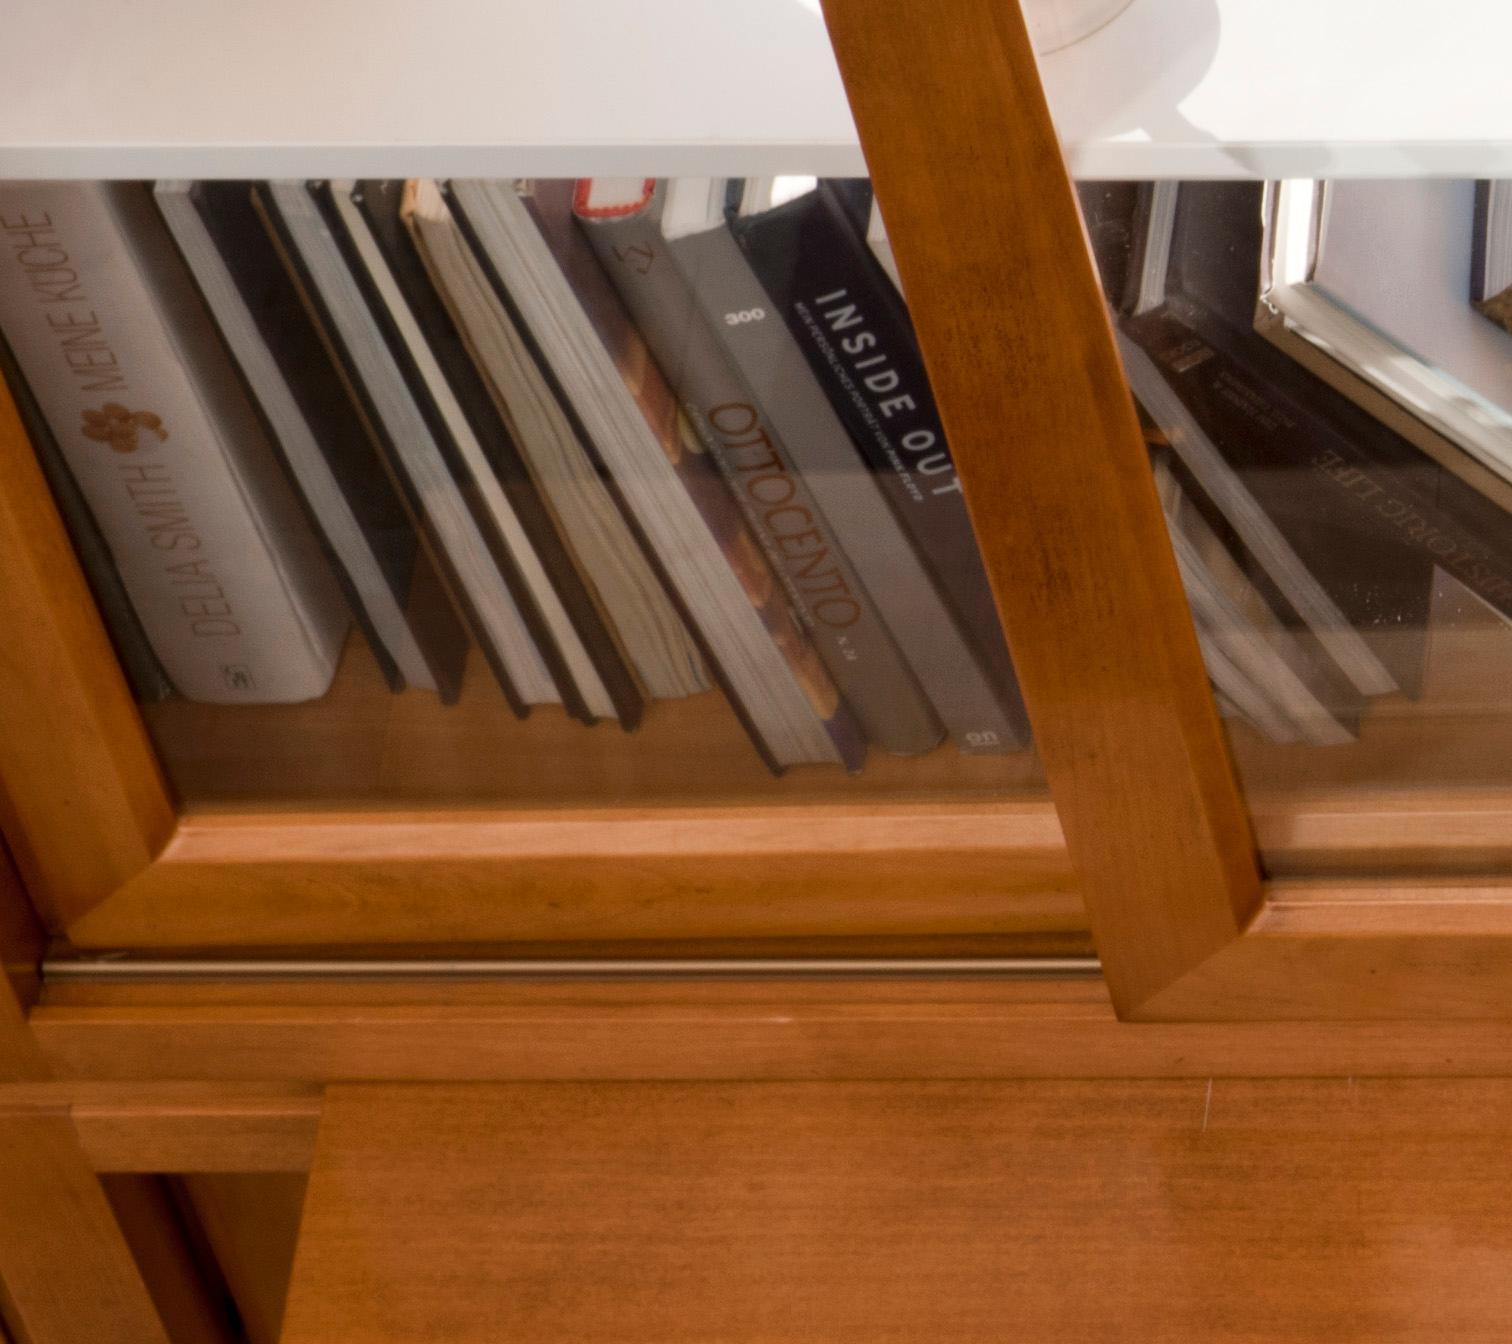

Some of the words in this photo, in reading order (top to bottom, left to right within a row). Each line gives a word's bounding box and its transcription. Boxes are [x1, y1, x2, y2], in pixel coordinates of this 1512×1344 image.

[45, 309, 130, 394] MEINE
[724, 306, 766, 327] 300
[815, 288, 918, 419] INSIDE
[901, 429, 966, 497] OUT
[120, 461, 203, 552] SMITH
[707, 401, 862, 630] OTTOCENTO
[165, 558, 242, 640] DELIA
